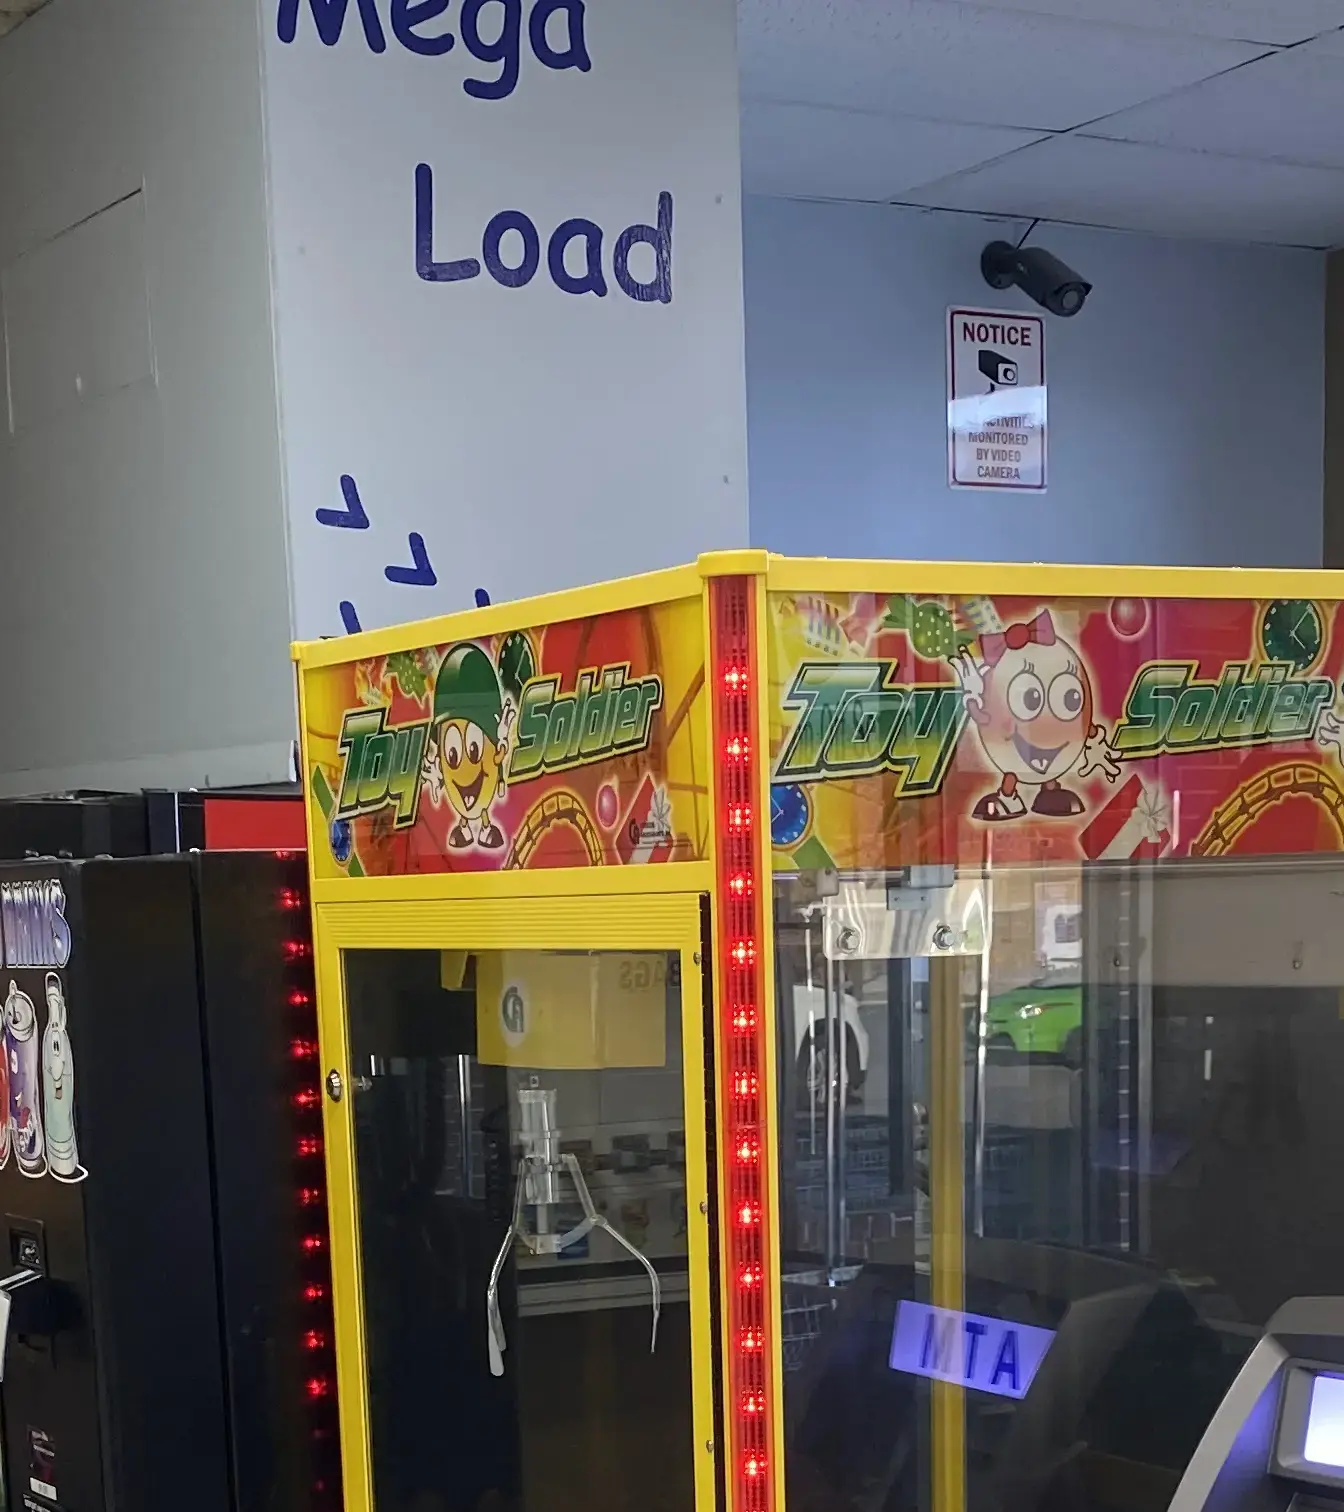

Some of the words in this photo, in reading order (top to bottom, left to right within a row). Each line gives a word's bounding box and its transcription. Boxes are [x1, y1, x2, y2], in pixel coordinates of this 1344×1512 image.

[414, 162, 674, 304] Load
[963, 321, 1032, 347] NOTICE
[968, 431, 1029, 446] MONITORED
[976, 448, 990, 462] BY
[991, 449, 1021, 463] VIDEO
[976, 465, 1021, 480] CAMERA
[774, 661, 968, 796] Toy
[1116, 660, 1332, 755] Soldier
[340, 708, 429, 828] Toy
[510, 666, 660, 780] Soldier
